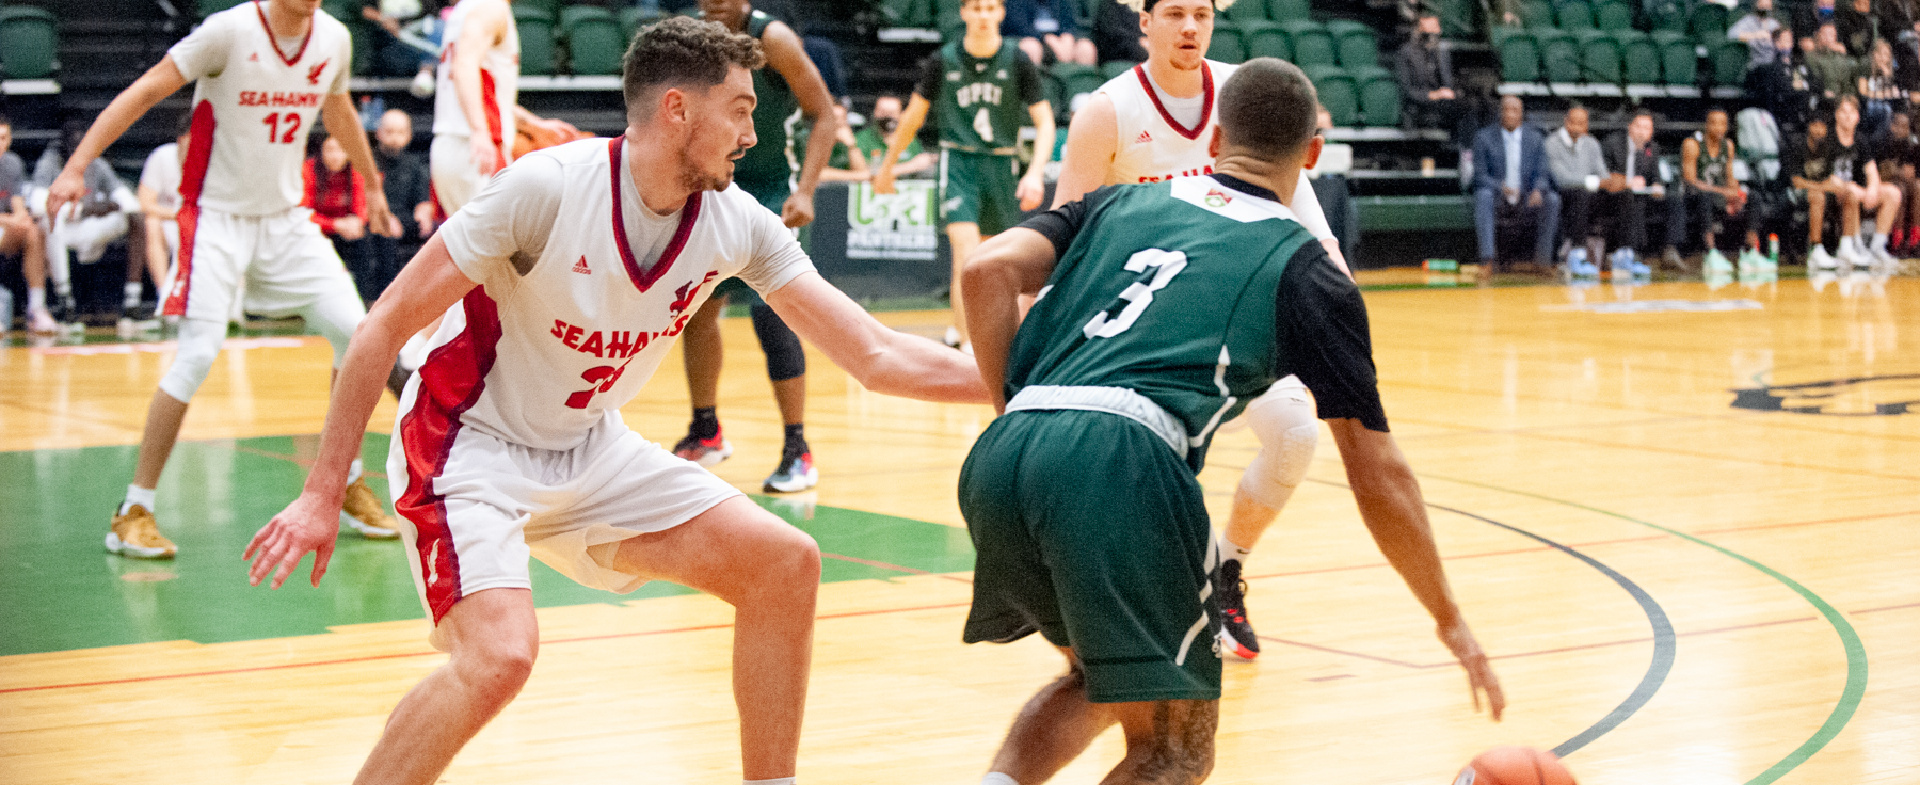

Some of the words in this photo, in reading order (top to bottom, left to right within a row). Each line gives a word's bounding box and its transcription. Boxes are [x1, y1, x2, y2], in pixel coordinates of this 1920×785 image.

[262, 112, 301, 143] 12
[973, 107, 994, 142] 4
[1083, 248, 1188, 340] 3
[550, 314, 690, 359] SEAHAS
